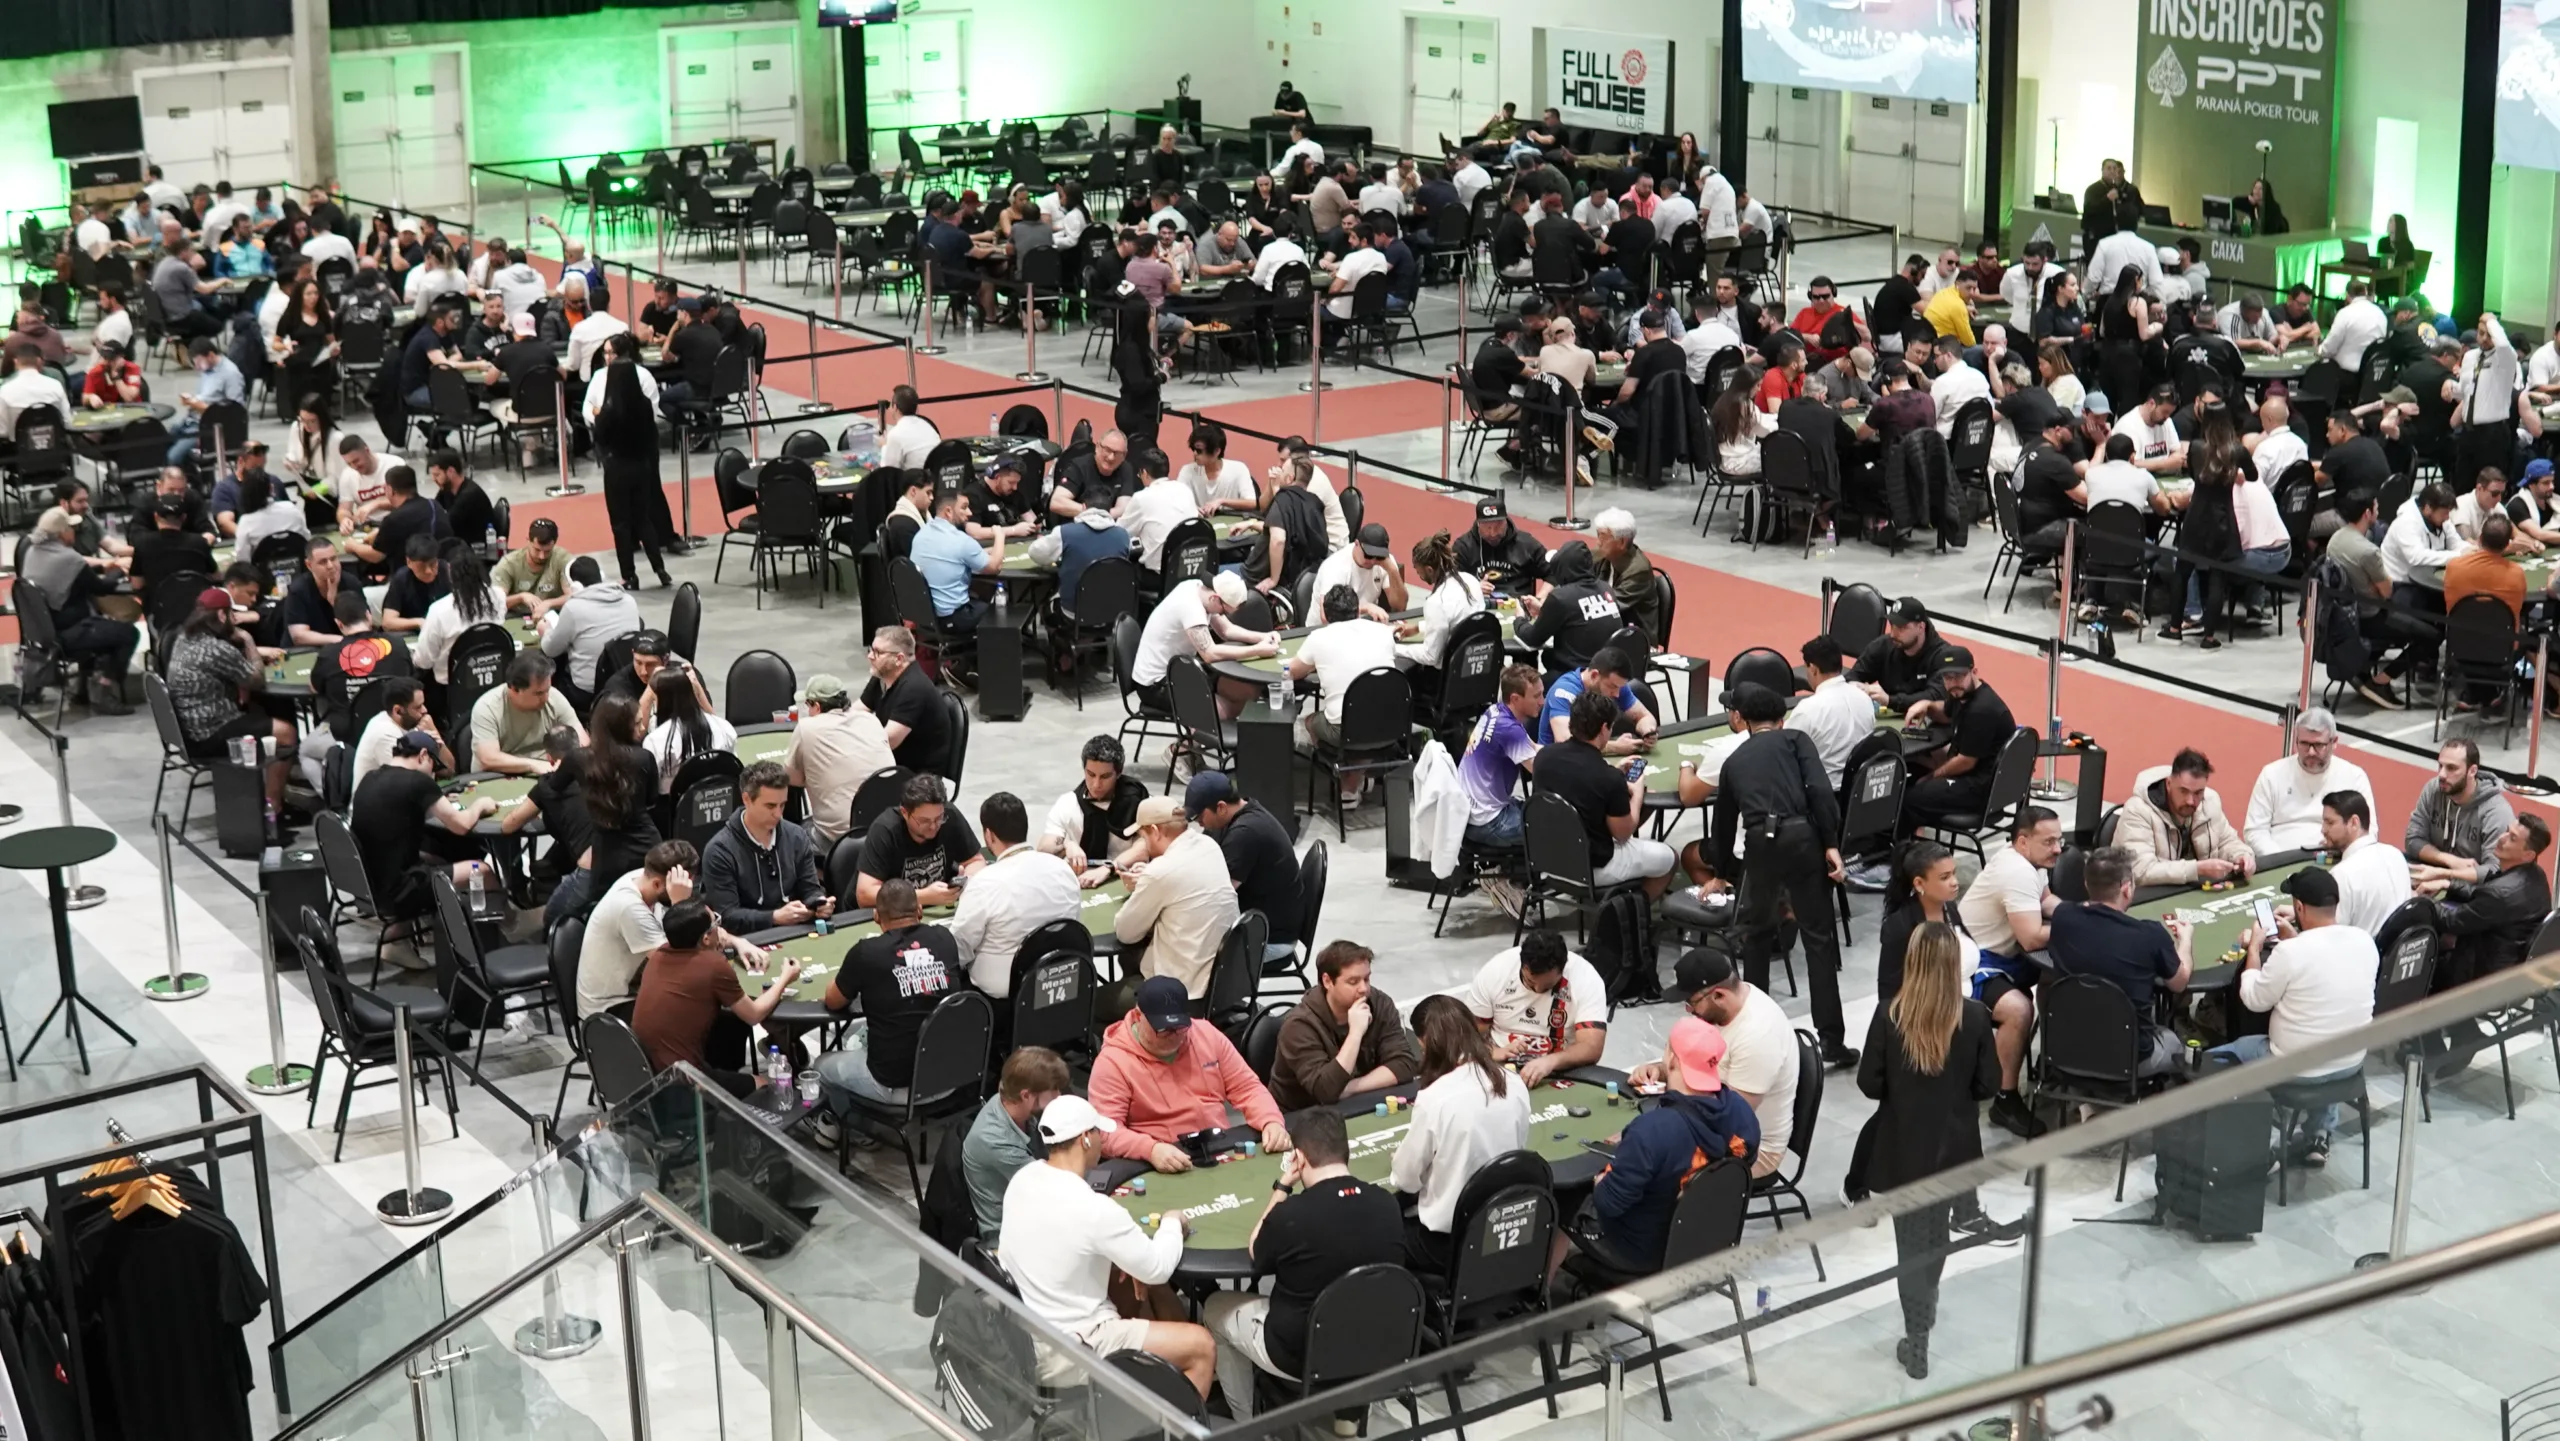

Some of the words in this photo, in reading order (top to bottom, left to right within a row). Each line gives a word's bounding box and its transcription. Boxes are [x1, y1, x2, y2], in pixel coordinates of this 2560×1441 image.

[1563, 49, 1618, 80] FULL
[2196, 56, 2321, 102] PPT
[1562, 78, 1646, 116] HOUSE
[2195, 95, 2242, 115] PARANÁ
[2243, 101, 2283, 120] POKER
[2285, 106, 2320, 126] TOUR
[1616, 114, 1645, 131] CLUB
[2211, 240, 2245, 263] CAIXA
[1186, 563, 1200, 576] 17
[472, 665, 498, 675] Mesa
[1470, 660, 1484, 675] 15
[477, 672, 494, 686] 18
[1868, 775, 1890, 787] Mesa
[705, 786, 733, 799] PPT
[1871, 783, 1886, 800] 13
[699, 800, 727, 810] Mesa
[704, 807, 722, 823] 16
[2399, 952, 2422, 966] Mesa
[1048, 961, 1079, 977] PPT
[2401, 961, 2416, 980] 11
[1041, 976, 1072, 991] Mesa
[1047, 986, 1067, 1005] 14
[1502, 1199, 1537, 1217] PPT
[1492, 1217, 1528, 1234] Mesa
[1498, 1227, 1521, 1251] 12
